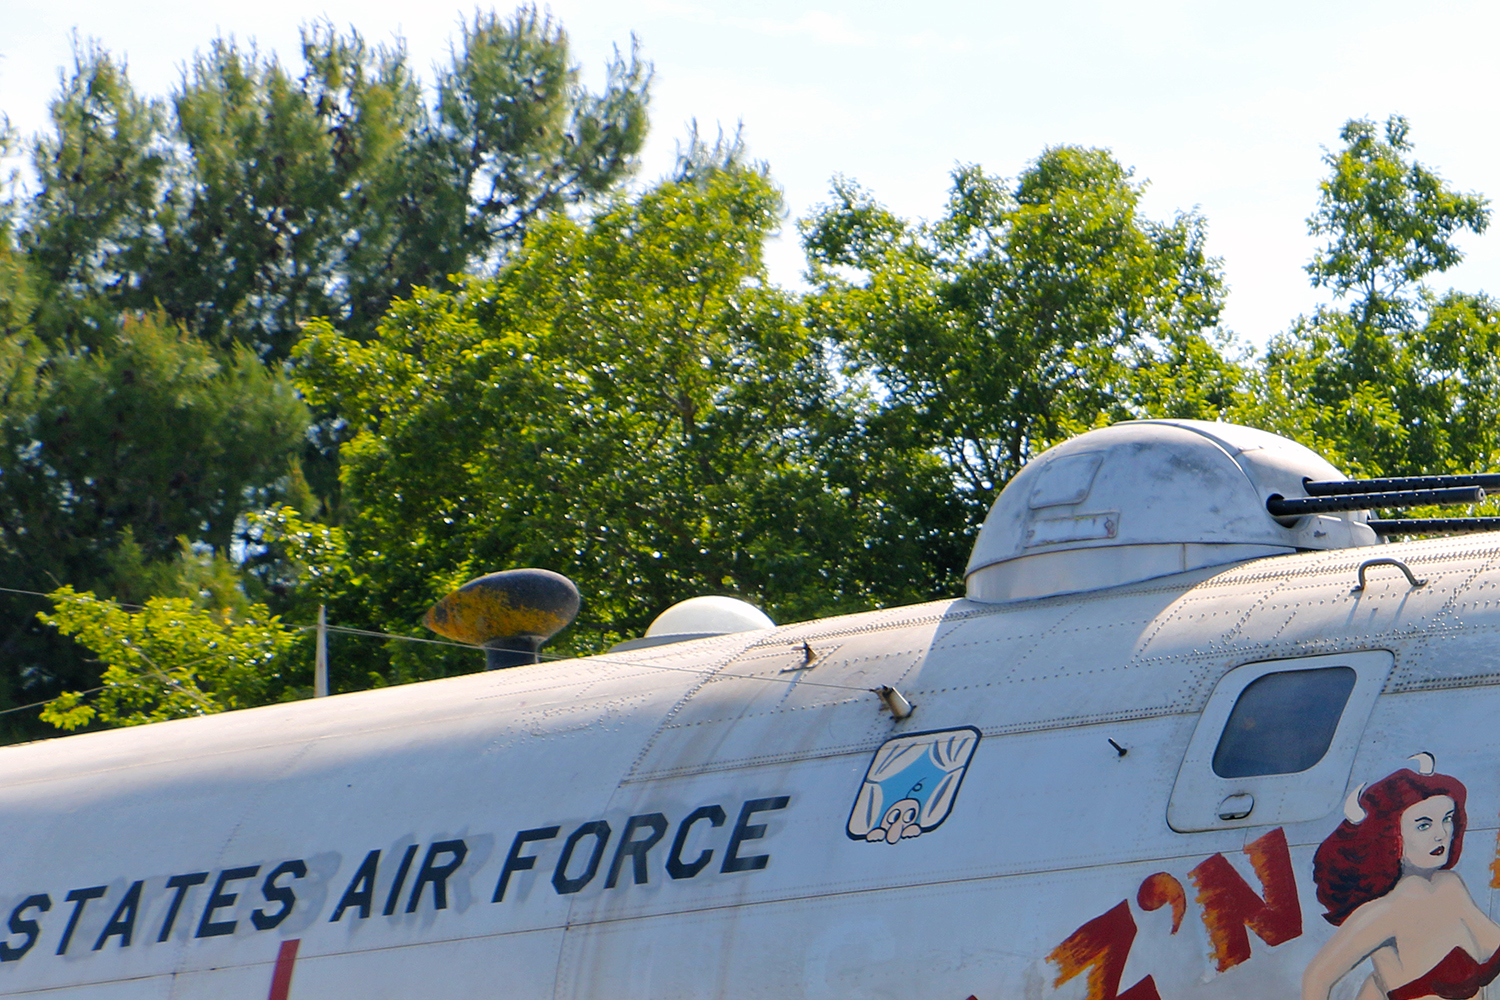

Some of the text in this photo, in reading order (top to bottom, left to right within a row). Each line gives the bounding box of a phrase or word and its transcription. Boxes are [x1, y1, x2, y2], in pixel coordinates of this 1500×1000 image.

[0, 795, 790, 962] STATES AIR FORCE
